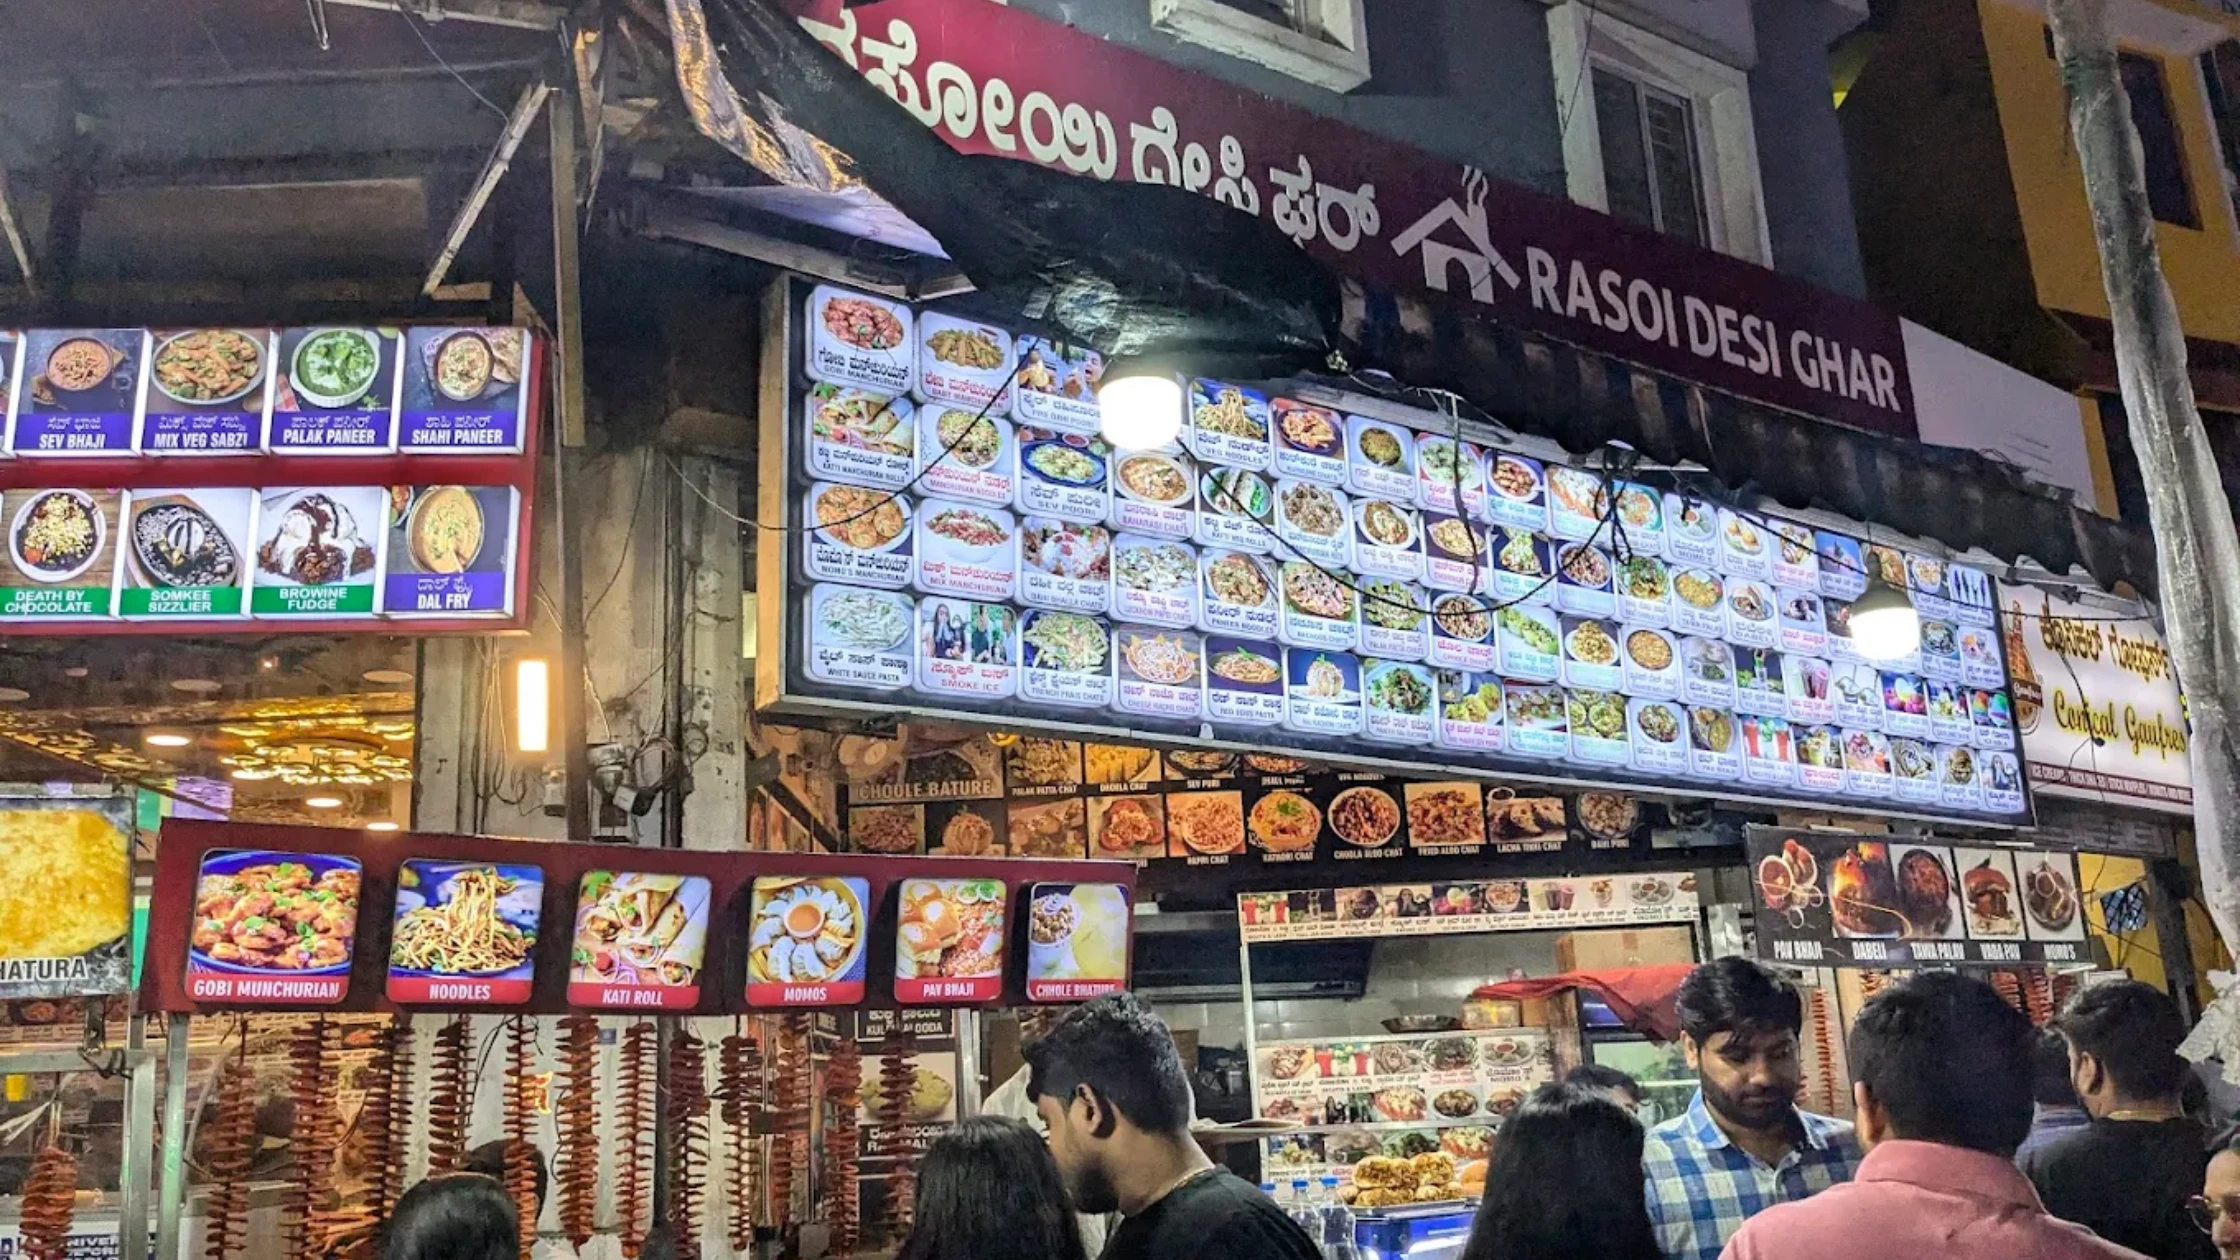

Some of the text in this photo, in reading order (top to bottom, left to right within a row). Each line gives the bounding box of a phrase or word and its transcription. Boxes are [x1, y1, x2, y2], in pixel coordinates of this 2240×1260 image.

[1267, 155, 1378, 251] ಘರ್
[1526, 246, 1901, 413] RASOI DESI GHAR
[824, 364, 904, 388] GOBI MANCHURIAN
[40, 433, 105, 449] SEV BHAJI
[154, 433, 248, 449] MIX VEG SABZI
[283, 429, 375, 444] PALAK PANEER
[412, 429, 503, 445] SHAHI PANEER
[1038, 499, 1058, 509] SEV
[855, 569, 905, 582] MANCHURIAN
[930, 578, 1007, 594] MIX MANCHURIAN
[15, 590, 85, 601] DEATH BY
[151, 590, 211, 601] SOMKEE
[280, 587, 347, 600] BROWINE
[5, 602, 92, 613] CHOCOLATE
[148, 602, 212, 613] SIZZLIER
[288, 599, 337, 610] FUDGE
[418, 593, 471, 609] DAL FRY
[1212, 619, 1274, 634] PANEER NOODLES
[827, 669, 900, 682] WHITE SAUCE PASTA
[941, 678, 999, 691] SMOKE ICE
[1255, 710, 1275, 719] PASTA
[2054, 690, 2186, 760] Conical Gaufres
[859, 779, 991, 799] CHOOLE BATURE
[1059, 785, 1077, 794] CHAT
[1384, 848, 1403, 856] CHAT
[1461, 845, 1480, 854] CHAT
[1543, 842, 1562, 851] CHAT
[1210, 855, 1229, 864] CHAT
[1294, 852, 1313, 861] CHAT
[1773, 940, 1793, 960] PAV
[1852, 941, 1887, 960] DABELI
[194, 979, 340, 998] GOBI MUNCHURIAN
[429, 983, 491, 1001] NOODLES
[784, 987, 827, 1001] MOMOS
[923, 982, 975, 997] PAV BHAJI
[1036, 983, 1071, 997] CHHOLE
[602, 989, 663, 1006] KATI ROLL
